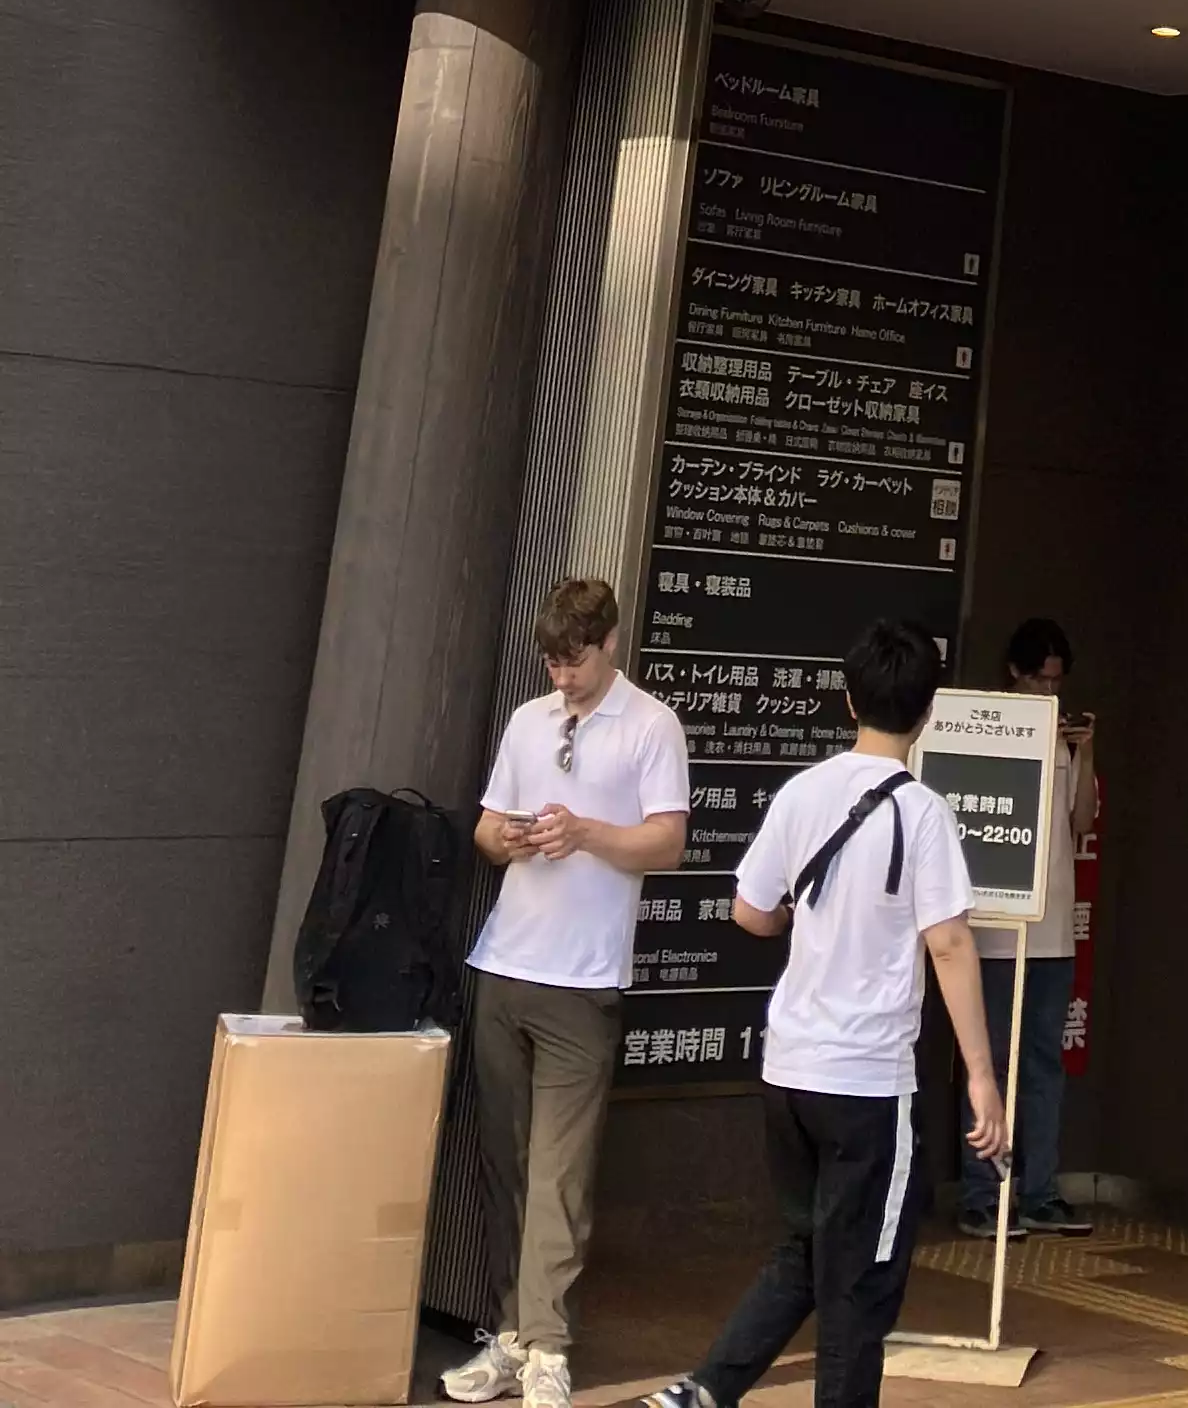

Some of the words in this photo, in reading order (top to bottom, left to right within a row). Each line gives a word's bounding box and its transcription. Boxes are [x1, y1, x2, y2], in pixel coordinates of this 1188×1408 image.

[714, 71, 820, 108] ベッドルーム家具
[704, 167, 744, 189] ソファ
[760, 175, 878, 214] リビングルーム家具
[692, 266, 778, 298] ダイニング家具
[790, 281, 861, 310] キッチン家具
[872, 293, 974, 326] ホームオフィス家具
[681, 351, 773, 382] 収納整理用品
[787, 365, 897, 396] テーブル・チェア
[908, 380, 949, 403] 座イス
[679, 377, 770, 408] 衣類収納用品
[784, 390, 921, 425] クローゼット収納家具
[670, 454, 802, 485] カーテン・ブラインド
[816, 468, 914, 497] ラグ・カーペット
[666, 505, 705, 520] Window
[758, 513, 782, 528] Rugs
[783, 515, 791, 529] &
[793, 516, 830, 532] Carpets
[838, 520, 880, 537] Cushions
[658, 571, 752, 599] 寝具・寝装品
[651, 611, 694, 629] Bedding
[645, 662, 760, 688] バス・トイレ用品
[756, 694, 822, 716] クッション
[970, 709, 1002, 722] ご来店
[934, 720, 1036, 738] ありがとうございます
[945, 792, 1013, 815] 営業時間
[661, 948, 718, 964] Electronics
[624, 1026, 726, 1066] 営業時間
